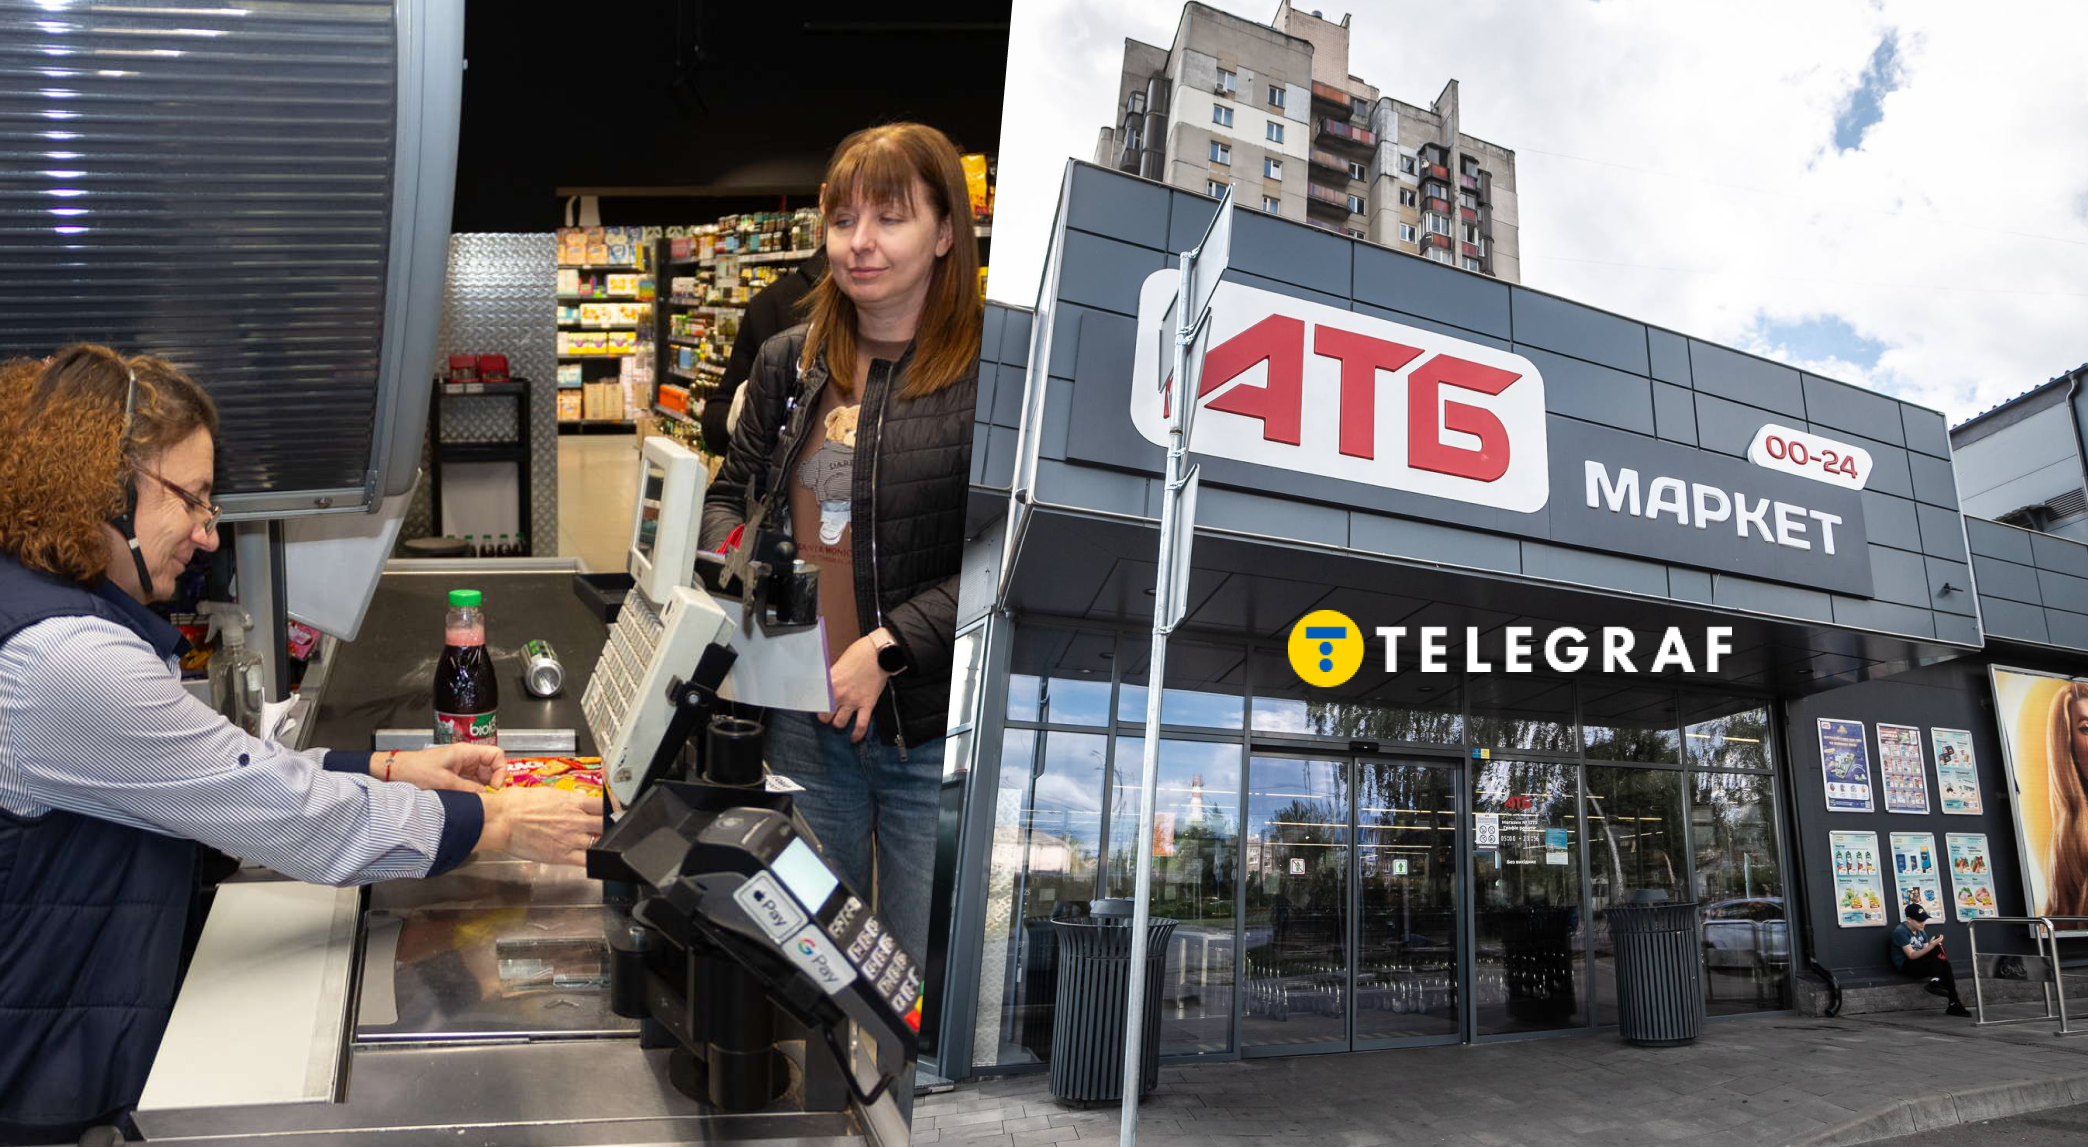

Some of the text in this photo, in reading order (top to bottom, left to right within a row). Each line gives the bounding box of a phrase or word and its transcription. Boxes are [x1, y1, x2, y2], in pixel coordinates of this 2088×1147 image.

[1164, 313, 1523, 483] АТБ
[1766, 434, 1859, 480] 00-24
[1584, 460, 1843, 556] МАРКЕТ
[762, 899, 787, 926] Pay
[811, 954, 839, 983] Pay
